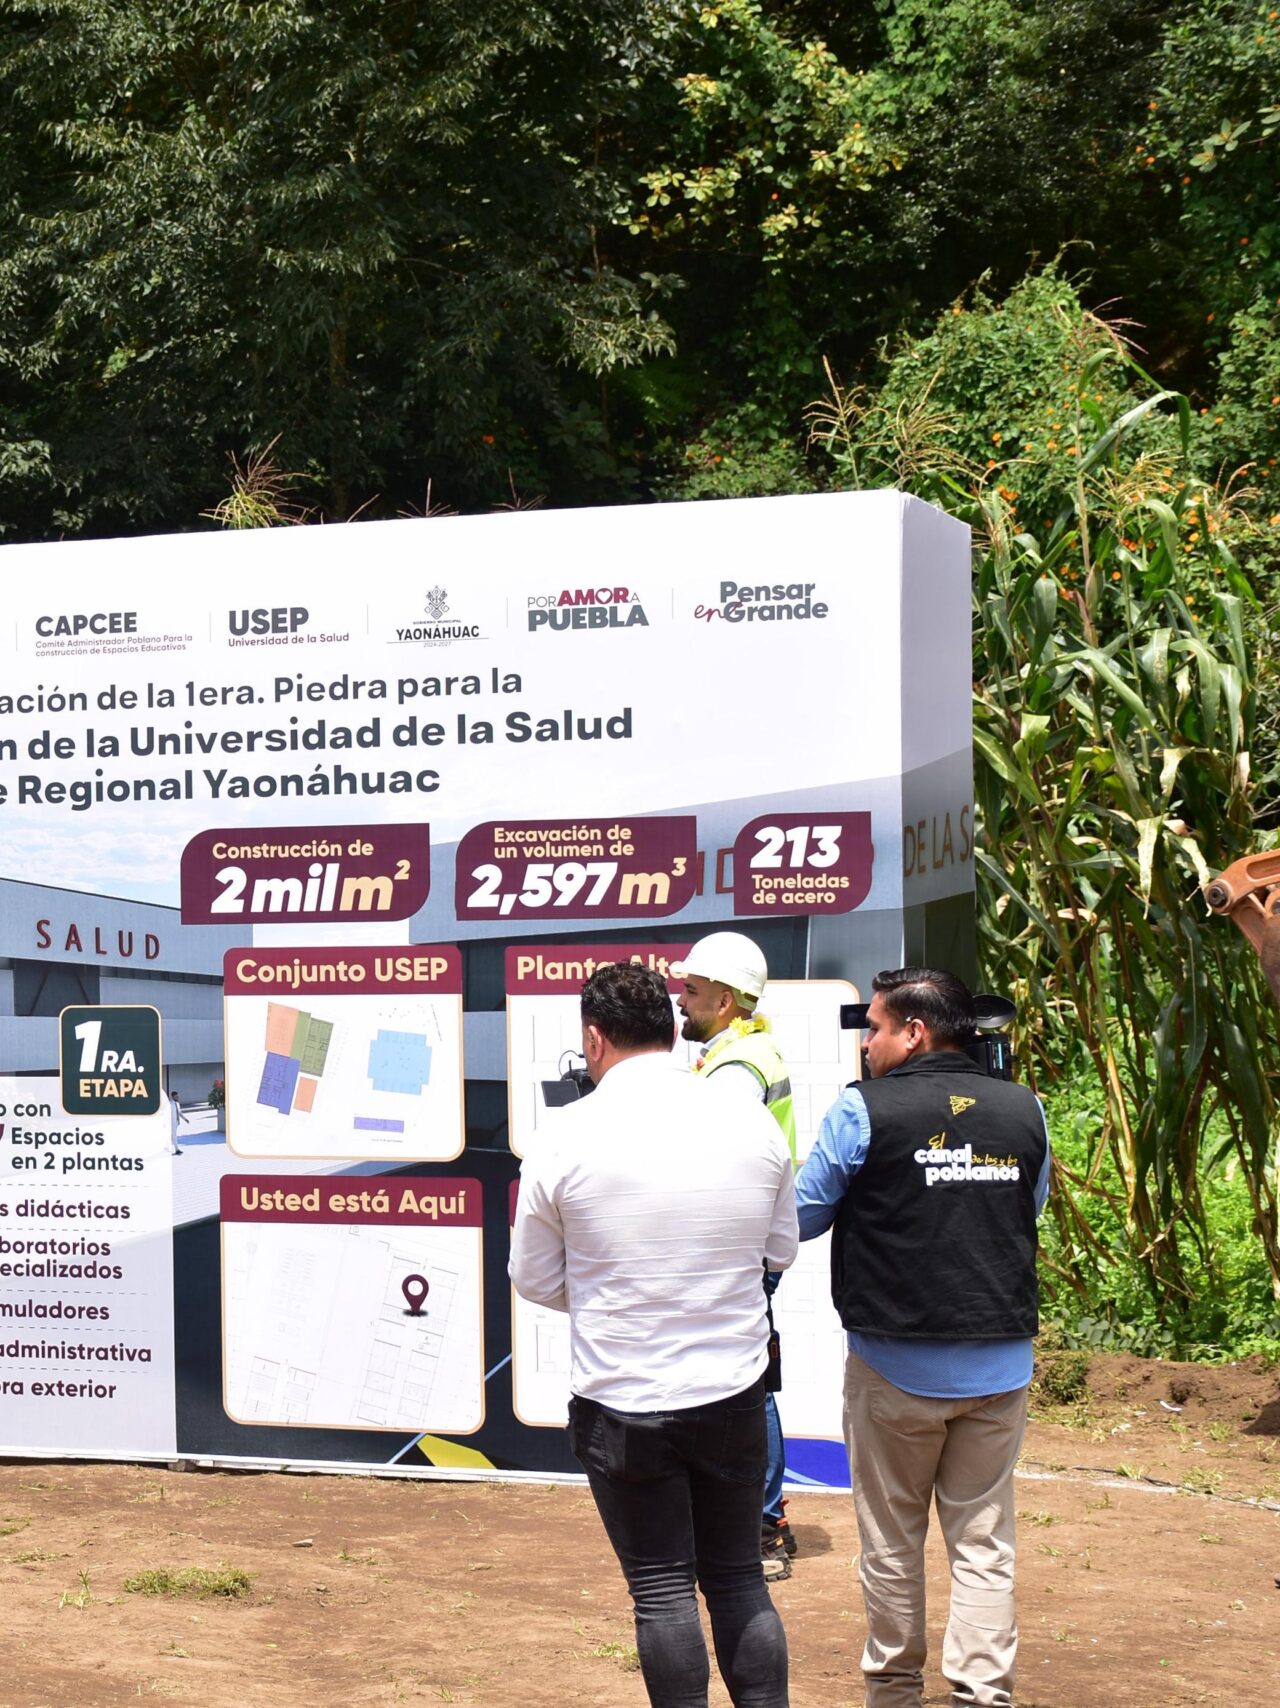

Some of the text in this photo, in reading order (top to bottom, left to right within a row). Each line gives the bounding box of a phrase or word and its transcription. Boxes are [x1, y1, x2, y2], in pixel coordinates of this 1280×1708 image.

[528, 587, 640, 608] POR AMOR A
[720, 581, 816, 603] Pensar
[229, 607, 309, 636] USEP
[528, 604, 649, 631] PUEBLA
[724, 600, 828, 622] Grande
[35, 612, 137, 637] CAPCEE
[396, 624, 480, 640] YAONÁHUAC
[35, 640, 65, 649] Comité
[67, 638, 125, 648] Administrador
[127, 636, 161, 644] Poblano
[185, 634, 193, 642] la
[35, 644, 186, 657] construcción de Espacios Educativos
[229, 633, 349, 647] Universidad de la Salud
[97, 685, 138, 710] de
[148, 683, 174, 708] la
[185, 681, 264, 707] 1era.
[274, 672, 387, 703] Piedra
[398, 674, 481, 705] para
[492, 667, 522, 694] la
[27, 730, 76, 760] de
[86, 728, 120, 758] la
[130, 716, 380, 756] Universidad
[392, 715, 446, 747] de
[457, 714, 493, 745] la
[505, 707, 632, 743] Salud
[19, 769, 193, 811] Regional
[204, 763, 440, 799] Yaonáhuac
[494, 824, 632, 843] Excavación de
[904, 803, 974, 878] DE LA S
[212, 839, 374, 859] Construcción de
[494, 841, 634, 859] un volumen de
[750, 825, 843, 869] 213
[467, 862, 618, 915] 2,597
[752, 873, 850, 889] Toneladas
[753, 889, 836, 905] de acero
[37, 919, 160, 960] SALUD
[236, 957, 448, 989] Conjunto USEP
[79, 1079, 149, 1098] ETAPA
[13, 1102, 51, 1117] con
[11, 1127, 105, 1149] Espacios
[11, 1152, 144, 1174] en 2 plantas
[914, 1144, 972, 1164] canal
[925, 1163, 1020, 1186] poblanos
[16, 1198, 131, 1219] didácticas
[241, 1186, 467, 1220] Usted está Aquí
[31, 1379, 116, 1398] exterior
